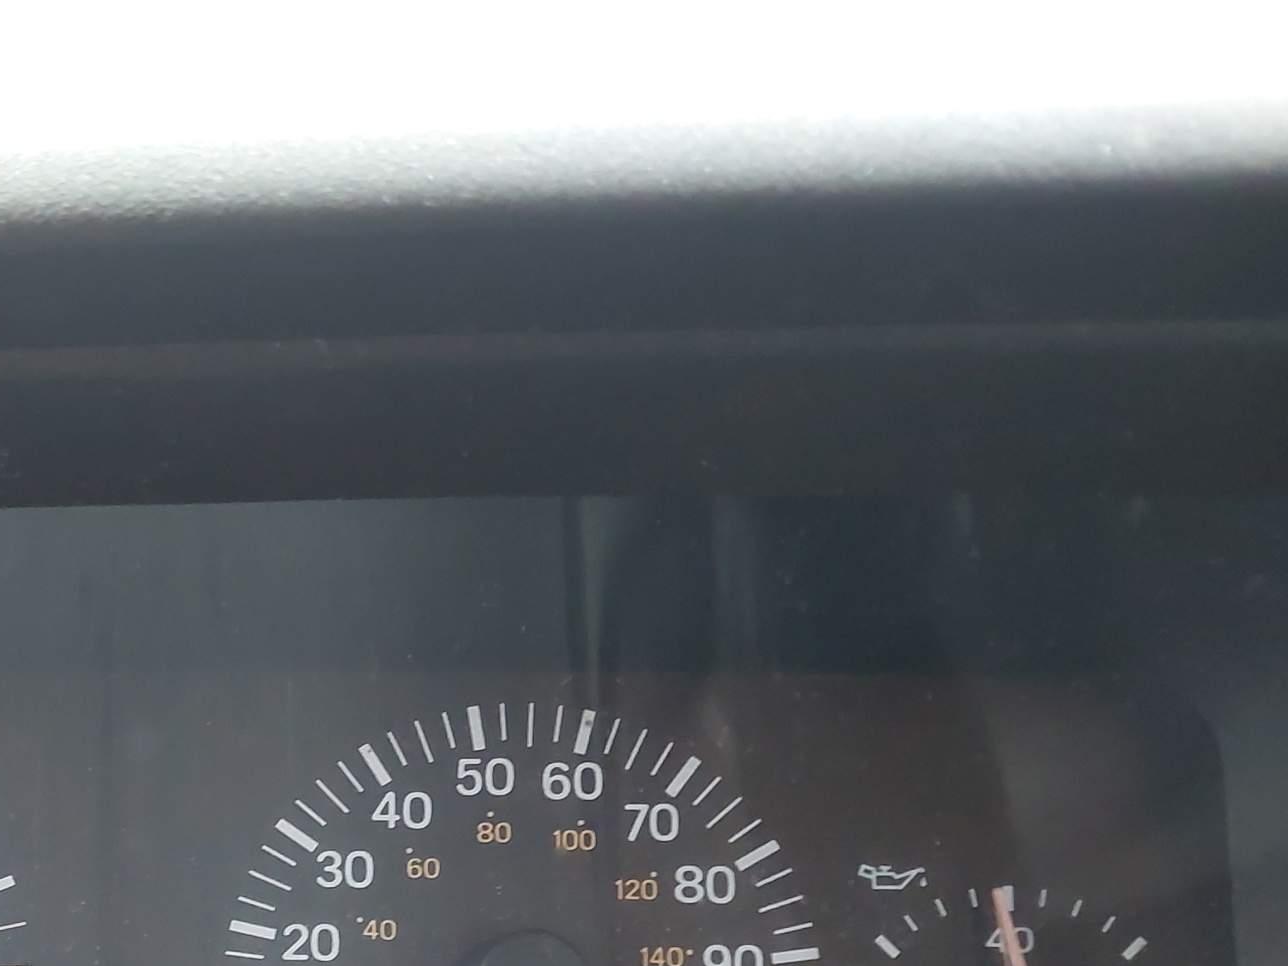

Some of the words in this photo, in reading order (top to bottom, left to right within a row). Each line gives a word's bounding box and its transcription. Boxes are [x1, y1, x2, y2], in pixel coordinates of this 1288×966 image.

[455, 757, 514, 797] 50
[541, 761, 603, 800] 60
[372, 791, 433, 829] 40
[623, 803, 680, 842] 70
[476, 822, 512, 844] 80
[552, 830, 596, 851] 100
[315, 850, 374, 889] 30
[406, 858, 441, 880] 60
[674, 865, 735, 904] 80
[615, 879, 658, 900] 120
[281, 923, 340, 962] 20
[362, 920, 397, 942] 40
